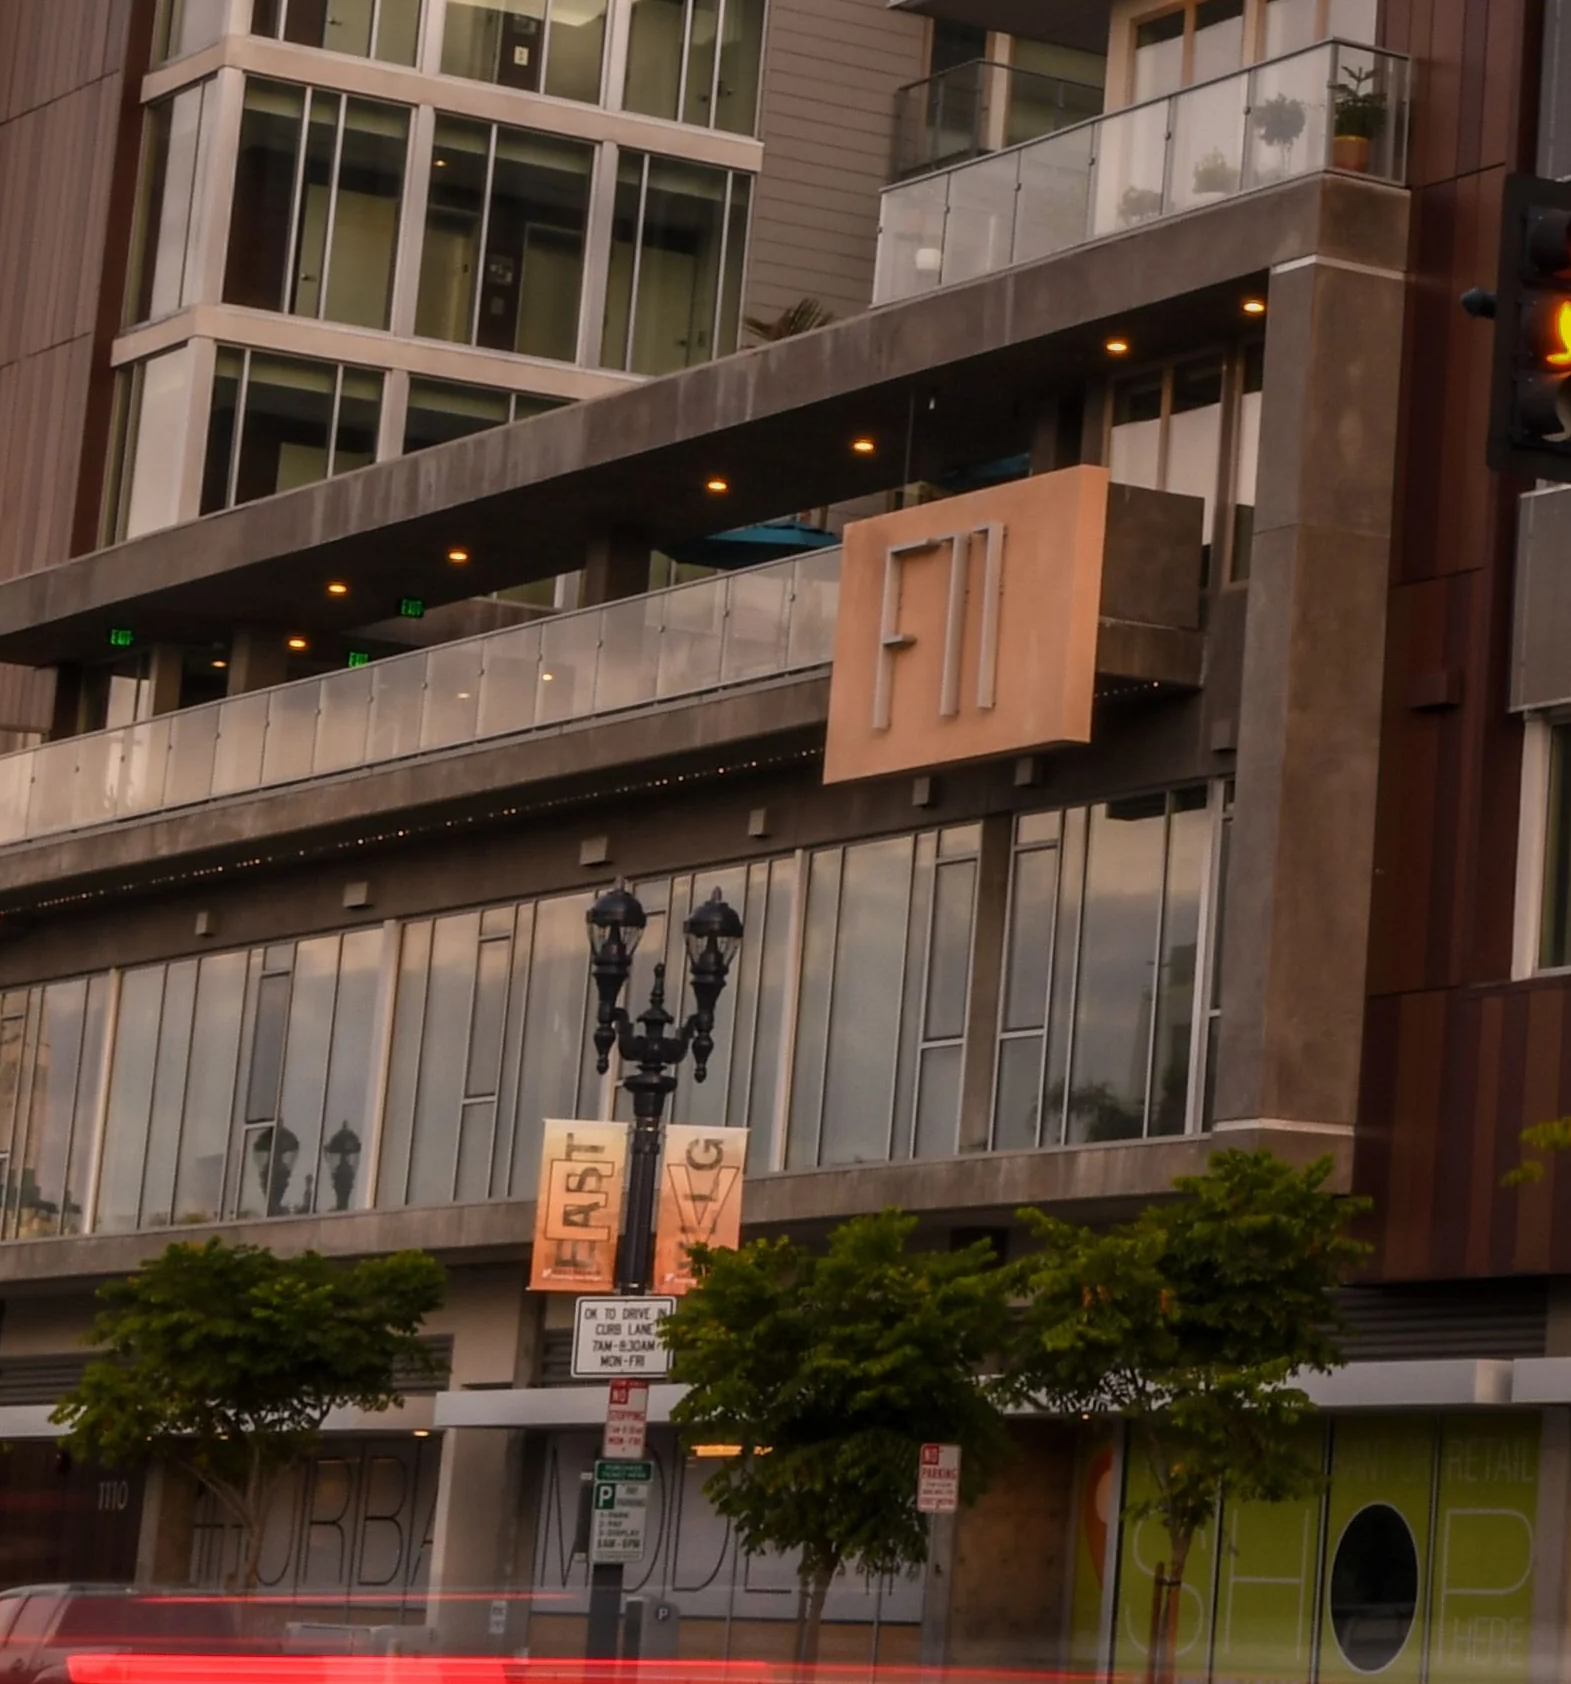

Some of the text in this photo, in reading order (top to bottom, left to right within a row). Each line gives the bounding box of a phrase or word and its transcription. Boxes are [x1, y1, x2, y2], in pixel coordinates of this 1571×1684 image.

[871, 521, 1007, 730] F11
[585, 1308, 598, 1320] OK
[605, 1308, 616, 1320] TO
[623, 1307, 651, 1320] DRIVE
[595, 1323, 655, 1336] CURB LANE
[600, 1355, 645, 1367] MON-FRI
[598, 1485, 613, 1508] P
